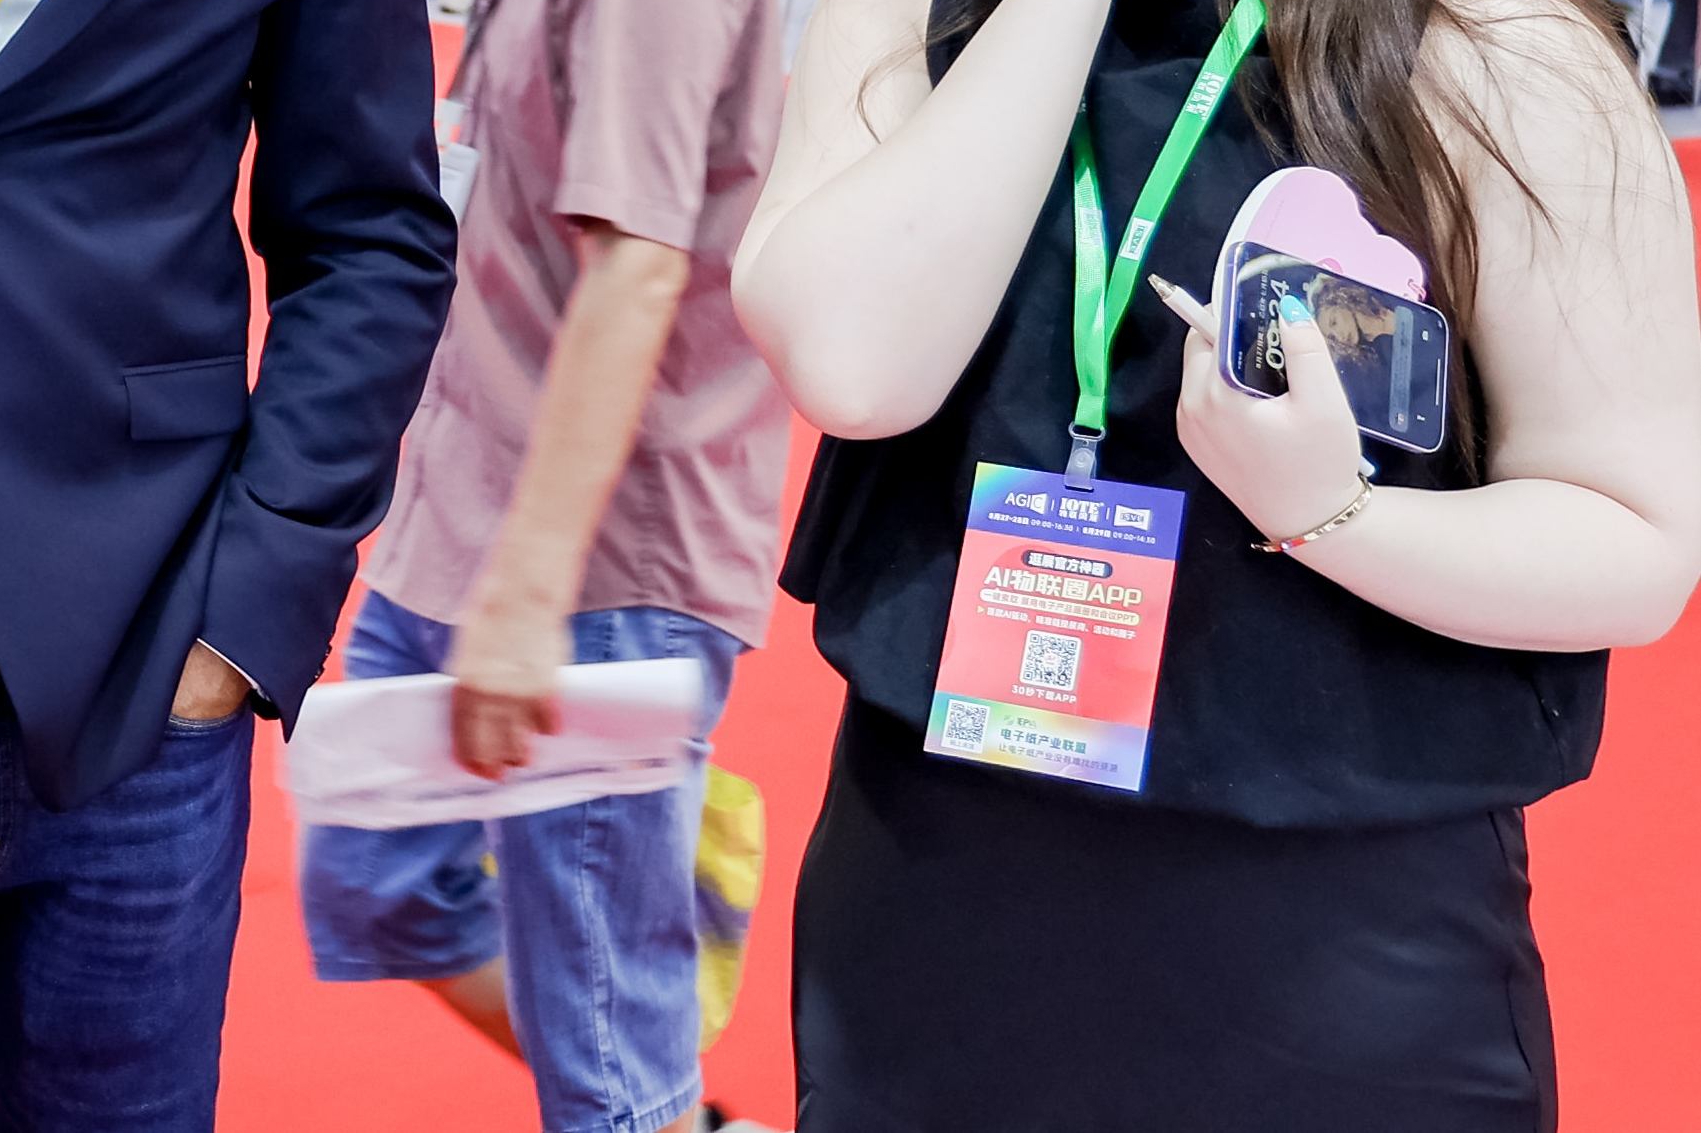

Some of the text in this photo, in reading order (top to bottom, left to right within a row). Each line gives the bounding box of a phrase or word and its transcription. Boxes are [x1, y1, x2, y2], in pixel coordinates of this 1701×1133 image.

[1005, 492, 1048, 515] AGIC
[984, 566, 1142, 608] AI物联圈APP
[1011, 684, 1077, 704] 30秒下载APP
[1000, 728, 1087, 755] 电子纸产业联盟
